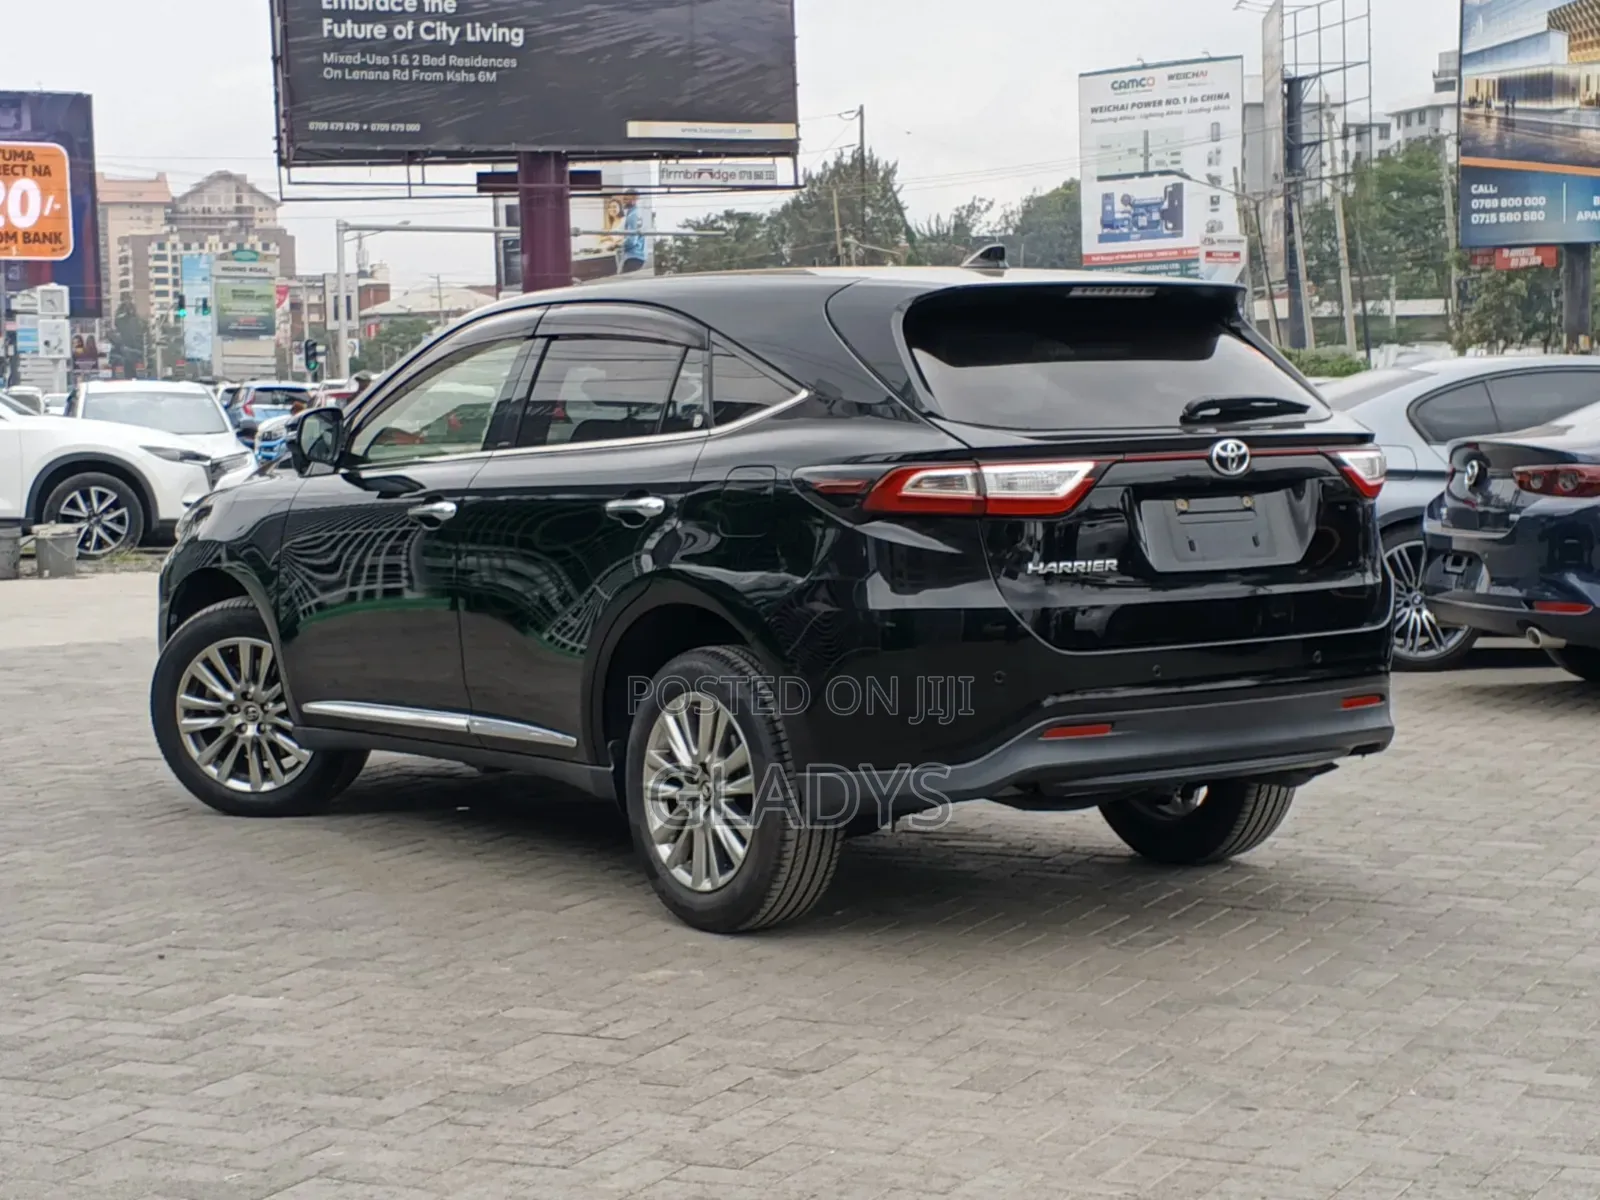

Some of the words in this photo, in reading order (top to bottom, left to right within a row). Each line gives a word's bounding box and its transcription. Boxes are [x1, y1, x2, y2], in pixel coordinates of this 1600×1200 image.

[423, 0, 458, 13] the
[321, 18, 388, 40] Future
[393, 20, 415, 41] of
[419, 21, 461, 46] City
[466, 22, 525, 47] Living
[322, 52, 390, 66] Mixed-Use
[391, 54, 397, 66] 1
[400, 54, 409, 66] &
[411, 54, 420, 66] 2
[422, 54, 447, 67] Bed
[449, 55, 518, 68] Residences
[323, 68, 343, 80] On
[345, 68, 391, 81] Lenana
[392, 68, 410, 81] Rd
[412, 69, 445, 82] From
[446, 69, 476, 82] Kshs
[477, 70, 497, 83] 6M
[1167, 70, 1208, 81] WEICHAI
[1130, 98, 1163, 110] POWER
[1189, 95, 1198, 104] in
[1200, 91, 1230, 103] CHINA
[0, 164, 28, 177] ECT
[32, 164, 52, 177] NA
[1470, 184, 1498, 194] CALL:
[0, 177, 61, 230] 0/-
[22, 231, 63, 245] BANK
[1027, 559, 1118, 575] HARRIER
